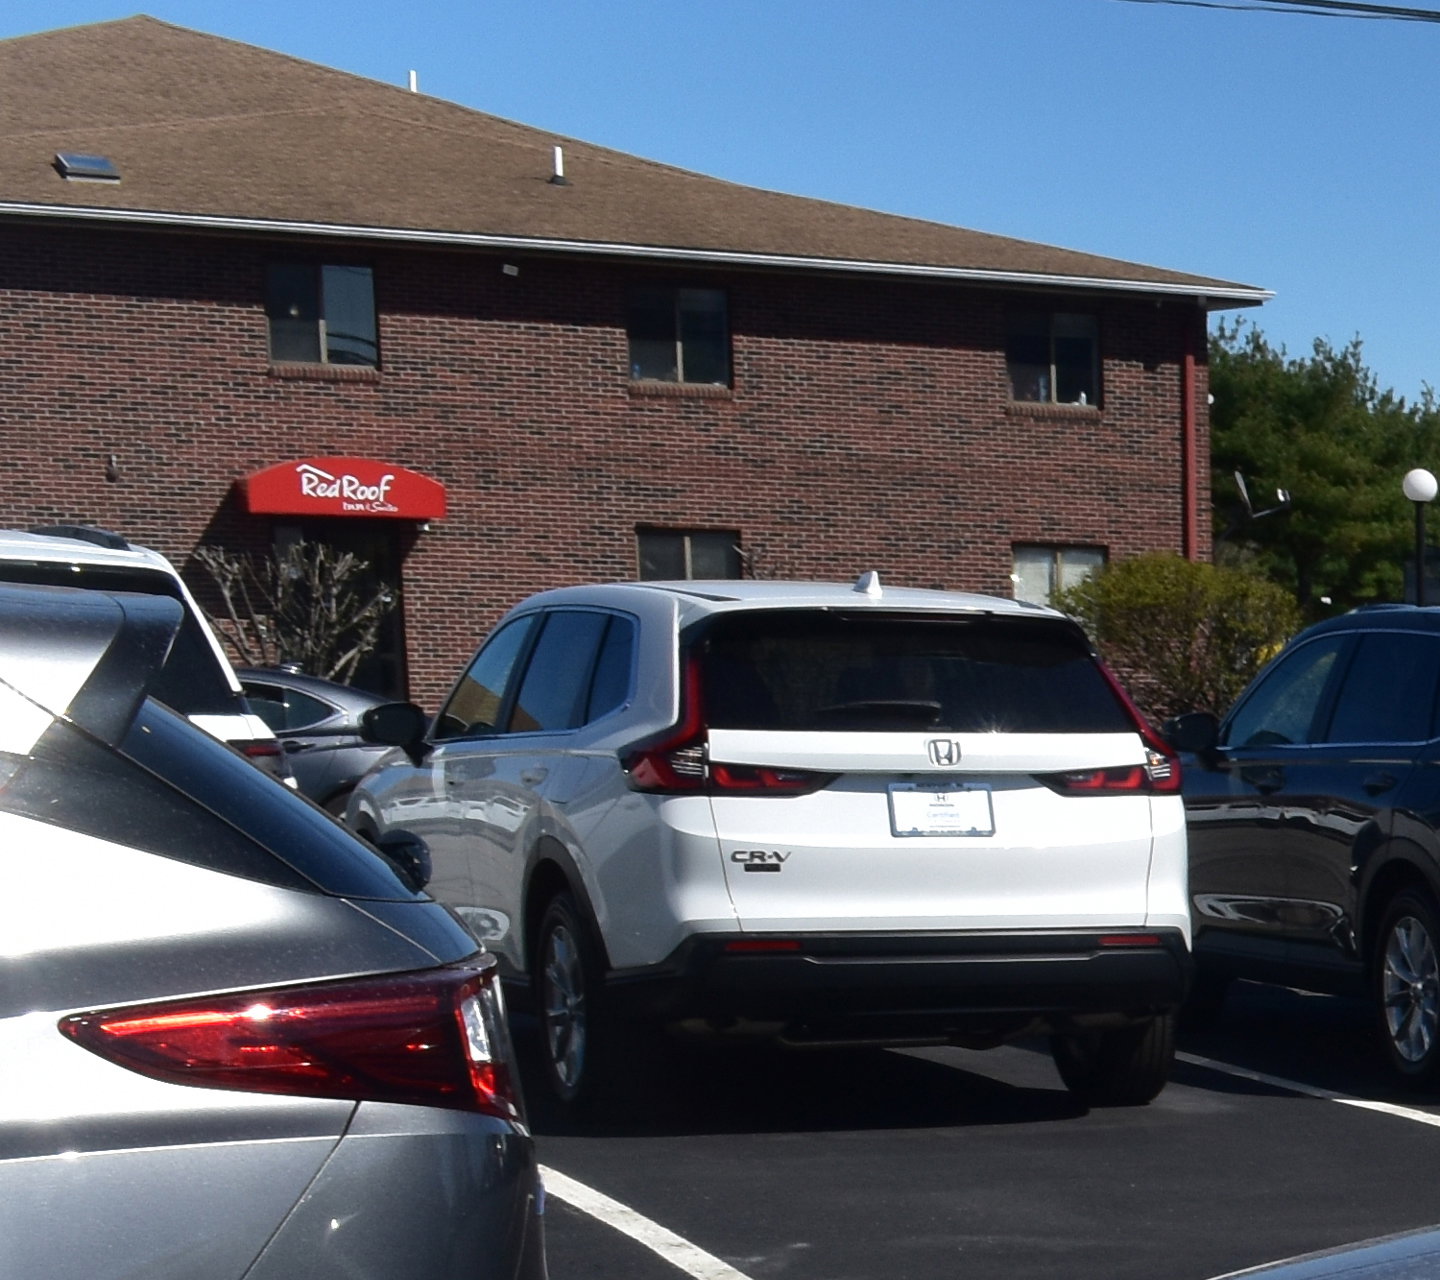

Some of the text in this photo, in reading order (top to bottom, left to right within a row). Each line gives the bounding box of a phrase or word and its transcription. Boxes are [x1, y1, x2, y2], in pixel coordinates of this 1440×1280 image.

[302, 473, 395, 501] Red Roof
[731, 851, 791, 863] CR-V
